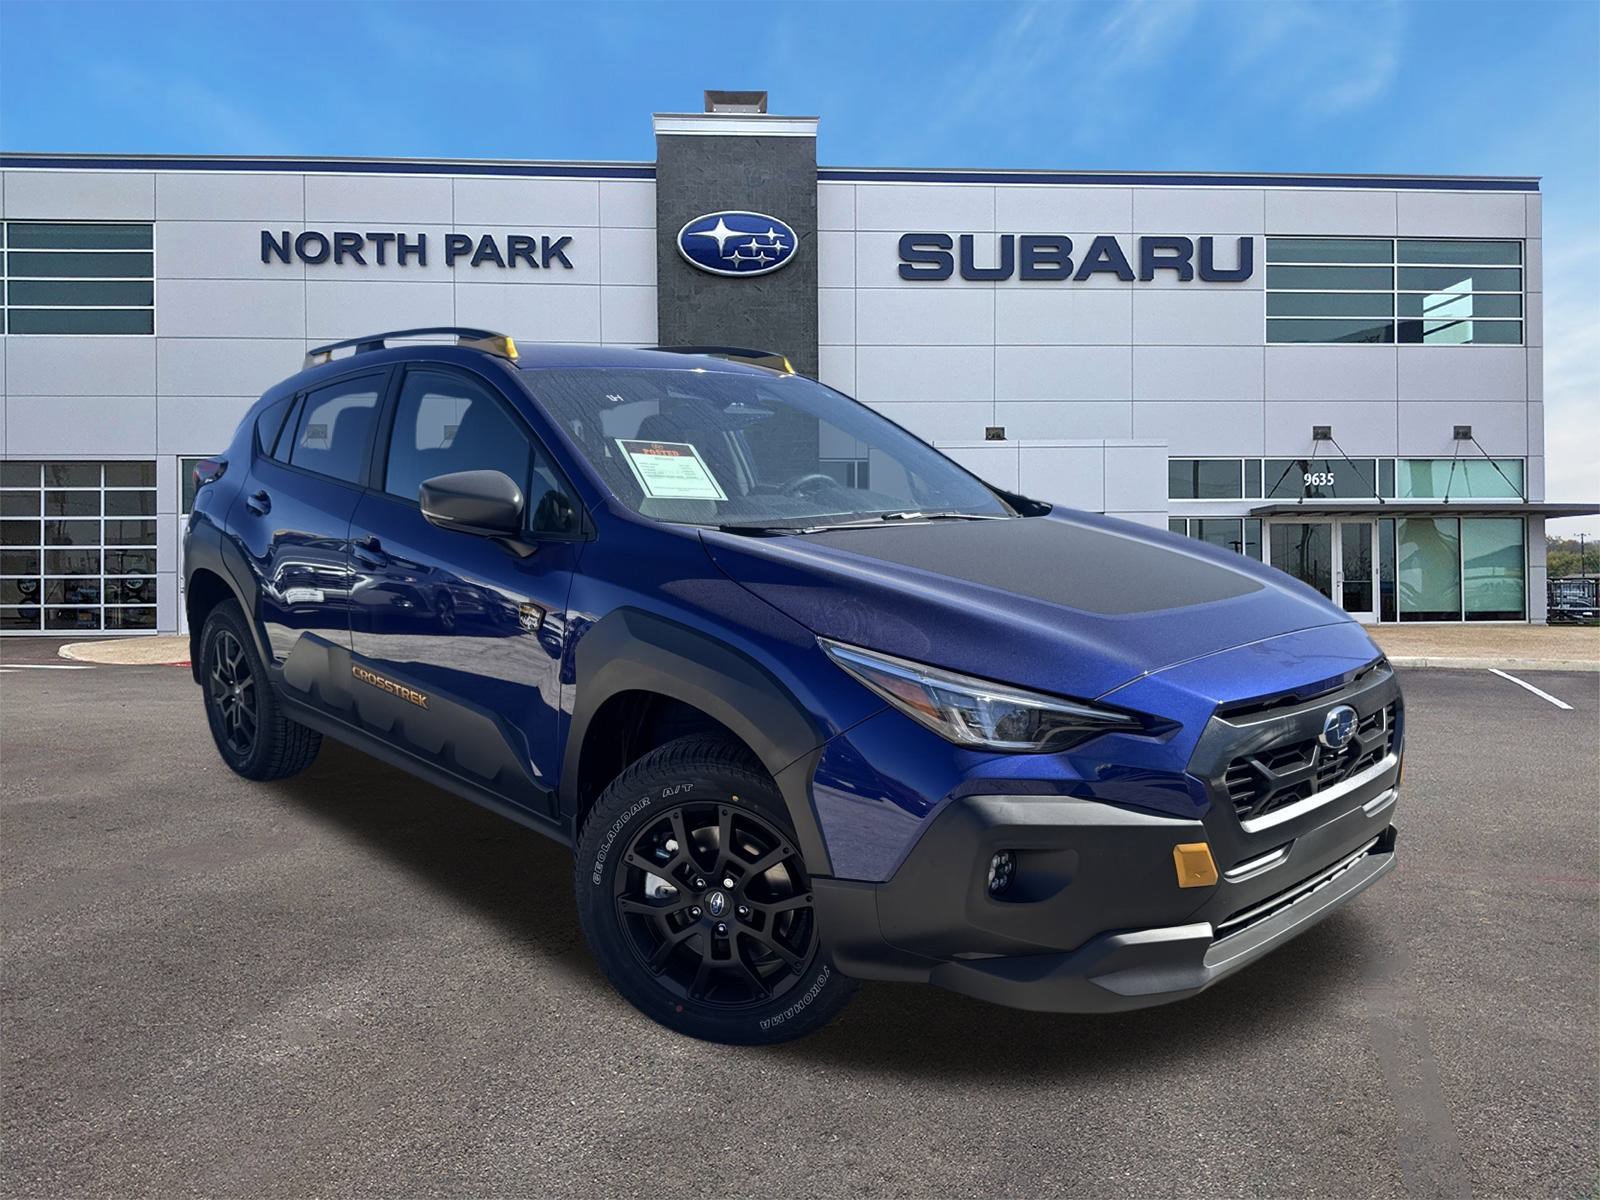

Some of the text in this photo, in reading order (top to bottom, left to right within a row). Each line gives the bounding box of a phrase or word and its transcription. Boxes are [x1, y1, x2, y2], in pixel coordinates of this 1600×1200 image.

[260, 230, 574, 269] NORTH PARK
[898, 233, 1254, 282] SUBARU
[1303, 472, 1335, 486] 9635
[352, 666, 428, 709] CROSSTREK
[592, 783, 693, 885] GEOLANDAR A/T
[760, 965, 830, 1029] YOKOHAMA
